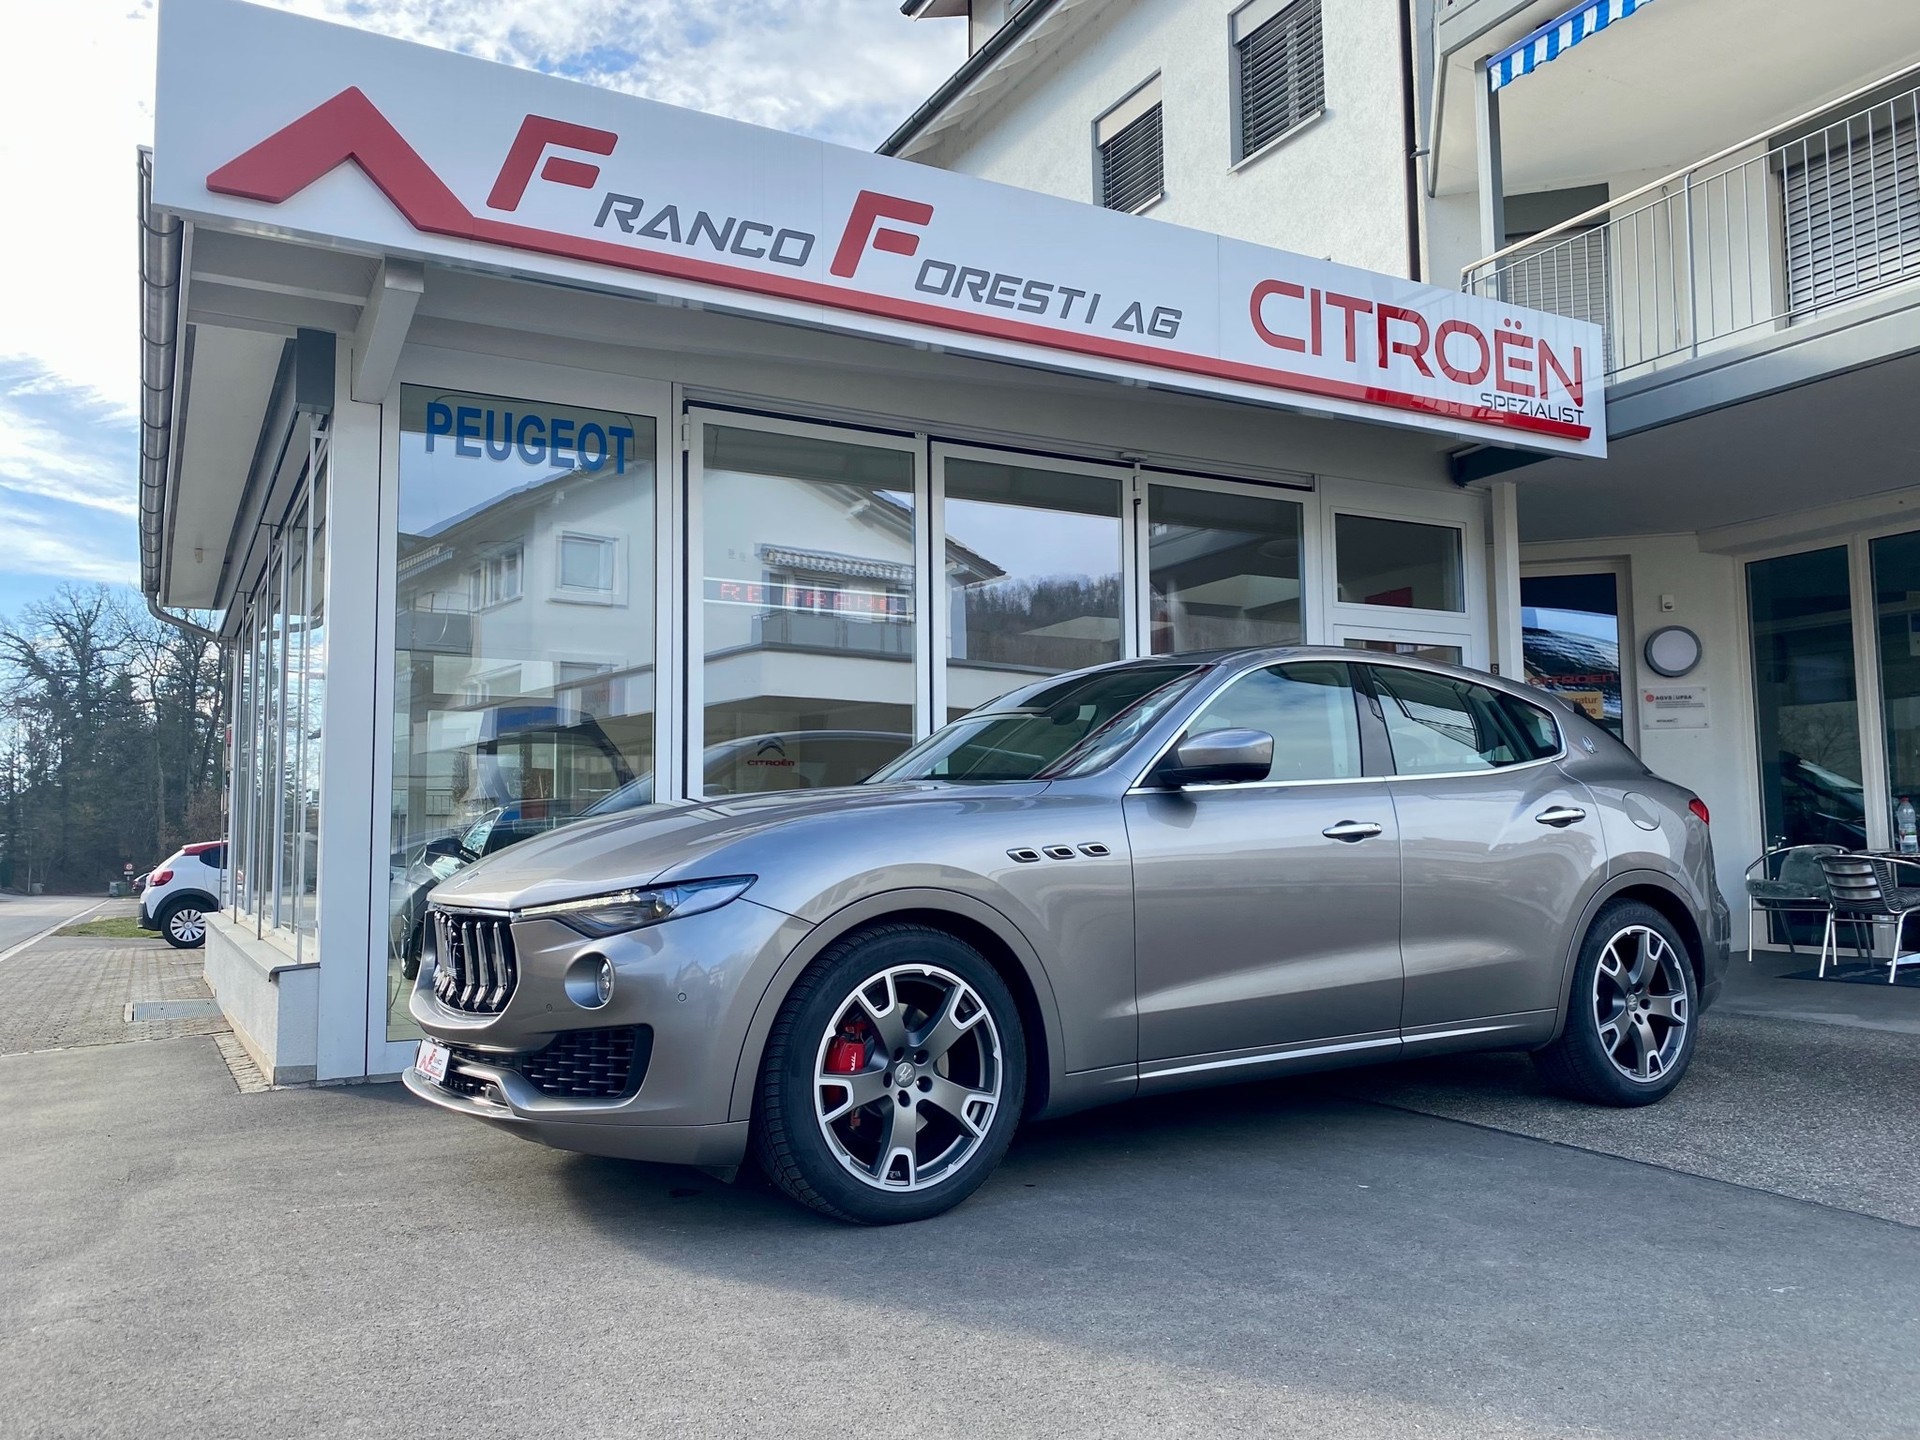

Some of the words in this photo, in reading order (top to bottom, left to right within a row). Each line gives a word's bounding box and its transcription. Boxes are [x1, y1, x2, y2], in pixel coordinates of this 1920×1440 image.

[485, 113, 816, 268] FRANCO
[829, 190, 1103, 324] FORESTI
[1112, 301, 1183, 340] AG
[1250, 278, 1585, 408] CITROËN
[425, 402, 634, 475] PEUGEOT
[1480, 392, 1585, 425] SPEZIALIST
